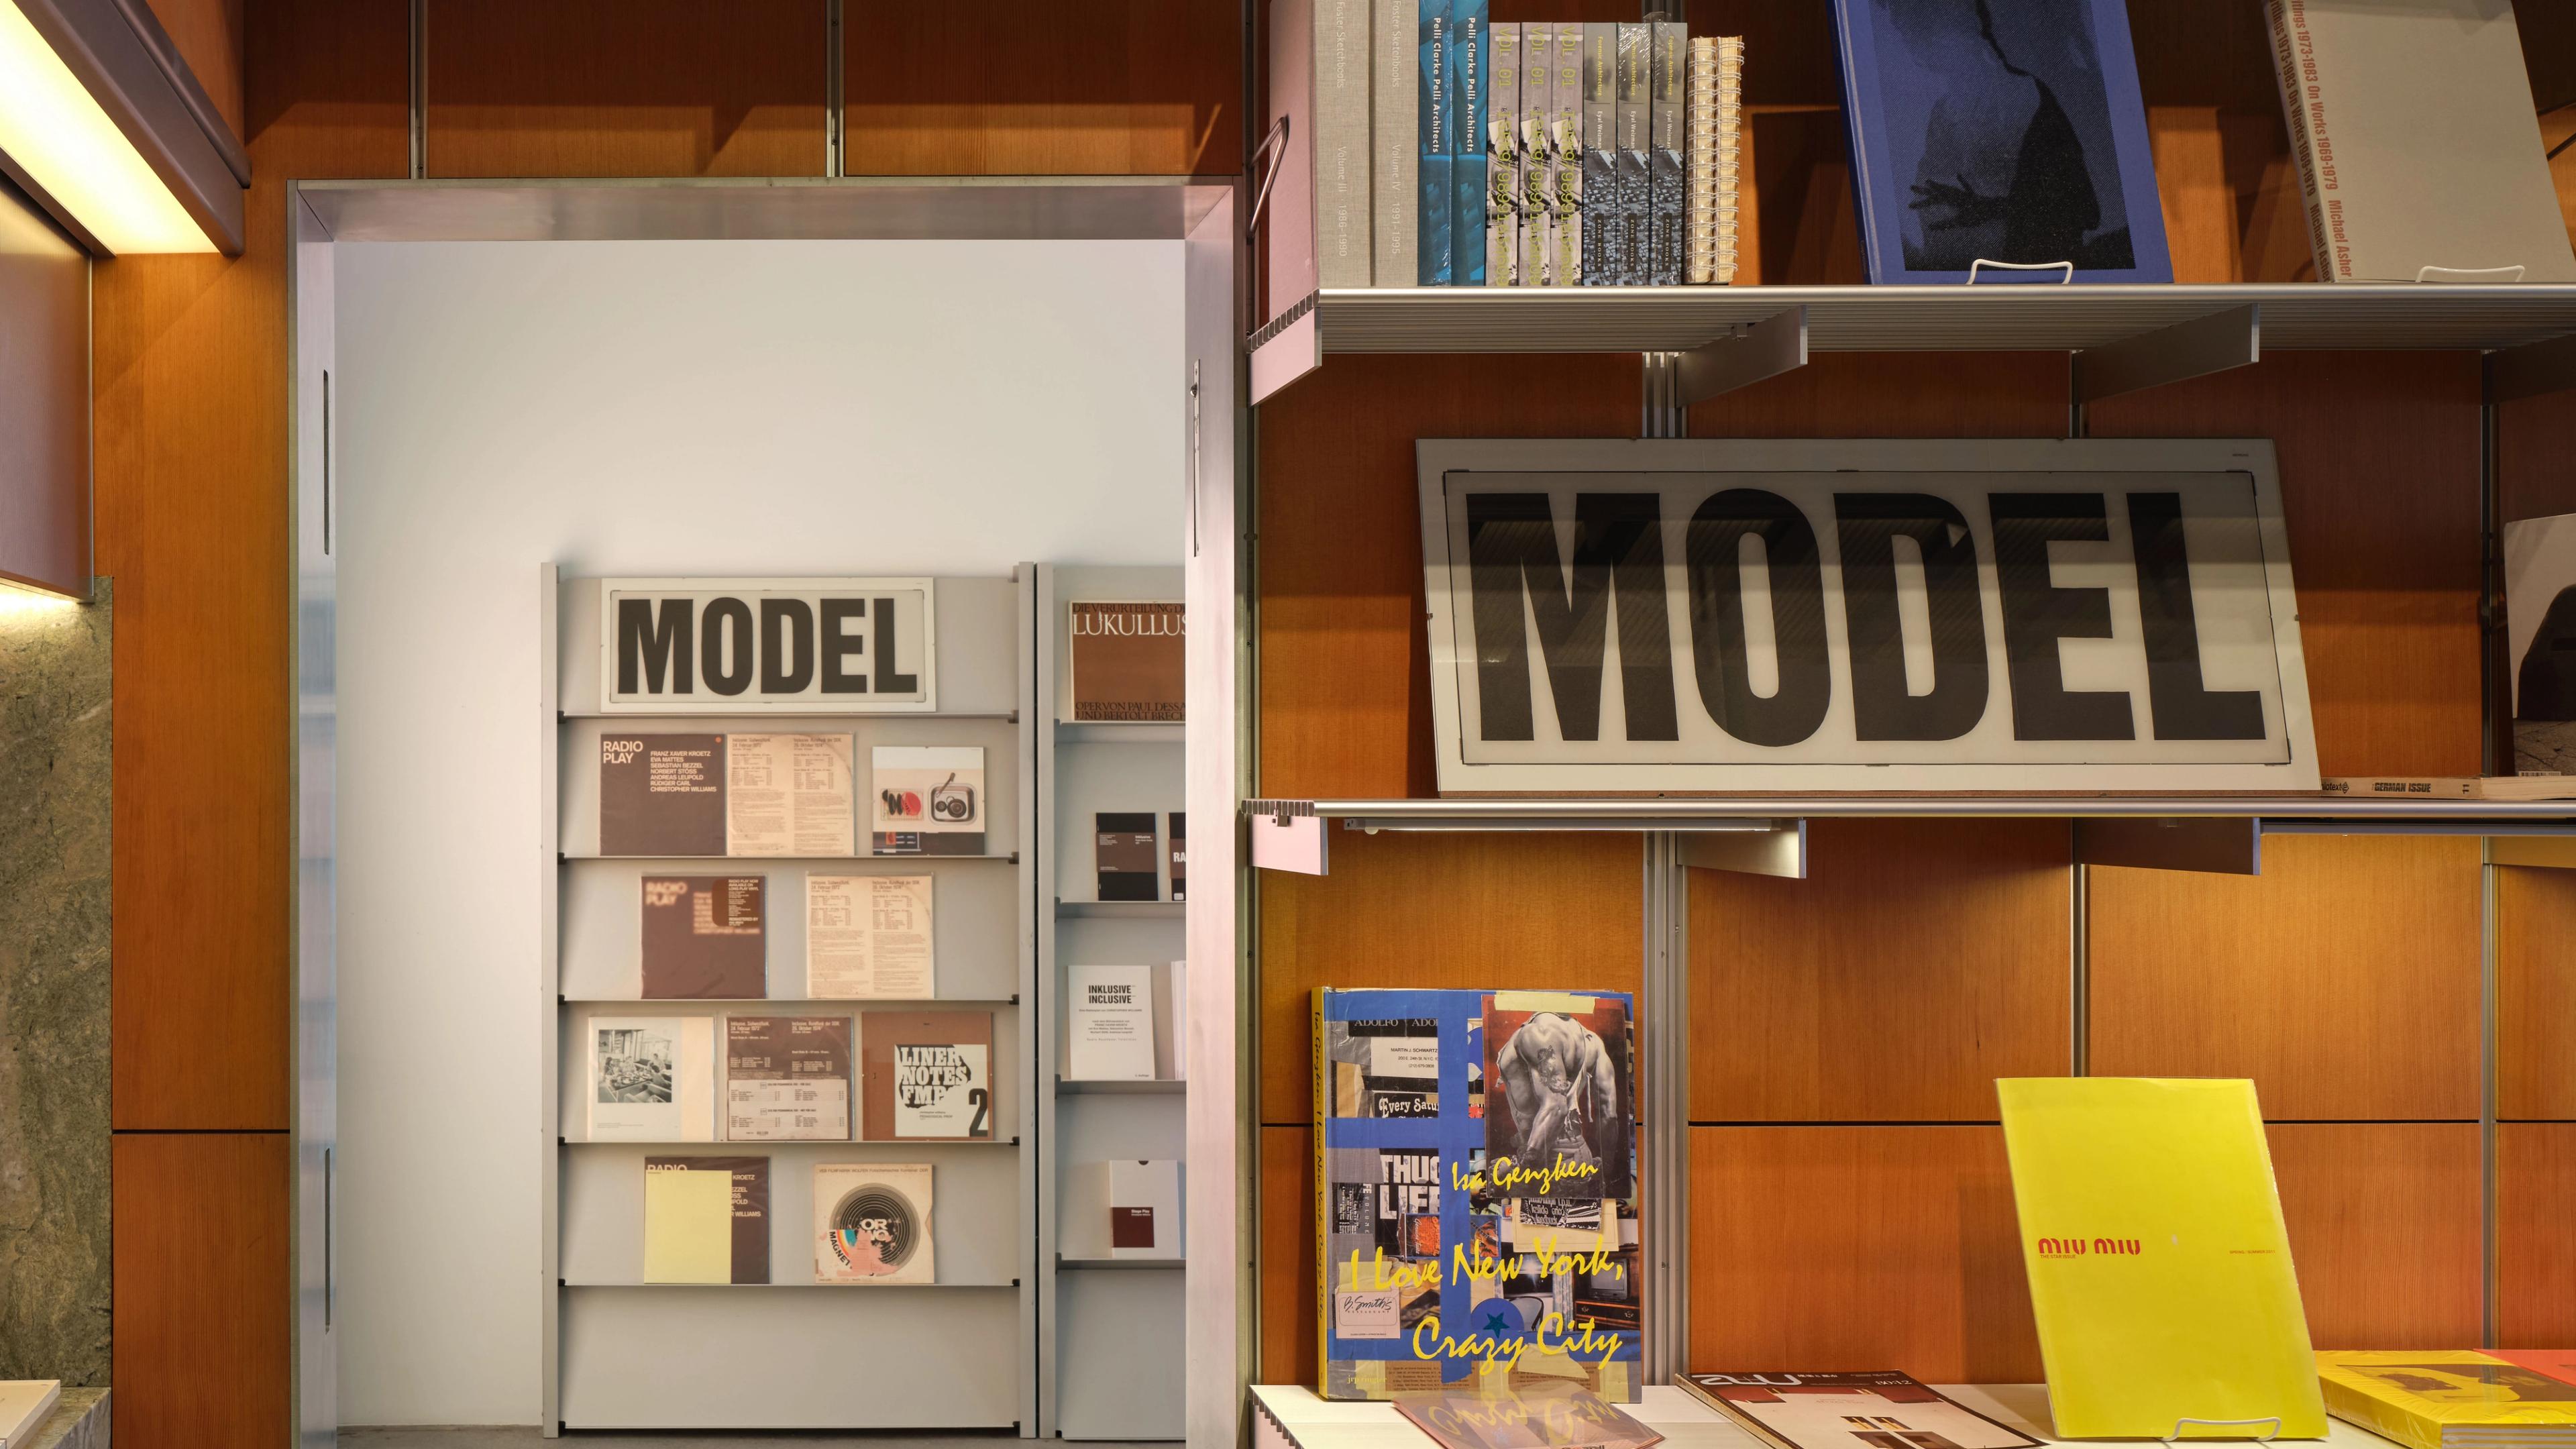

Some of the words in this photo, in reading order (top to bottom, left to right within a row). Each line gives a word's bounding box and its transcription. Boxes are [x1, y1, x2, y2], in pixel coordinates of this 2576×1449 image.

[1468, 17, 1476, 39] Pelli
[1336, 32, 1346, 89] Sketchbooks
[1391, 31, 1401, 87] Sketchbooks
[1468, 42, 1476, 74] Clarke
[2277, 34, 2300, 89] 1973-1983
[2297, 30, 2318, 82] 1973-1983
[1467, 78, 1475, 100] Pelli
[2288, 90, 2301, 105] On
[2307, 85, 2320, 99] On
[1432, 103, 1440, 153] Architects
[1467, 103, 1475, 152] Architects
[2291, 107, 2306, 142] Works
[2311, 102, 2327, 135] Works
[1338, 146, 1346, 180] Volume
[1391, 144, 1401, 178] Volume
[2298, 140, 2316, 197] 1969-1979
[2317, 137, 2338, 190] 1969-1979
[1391, 181, 1401, 191] IV
[2310, 203, 2325, 248] Michael
[2328, 200, 2348, 243] Michael
[2316, 250, 2331, 282] Asher
[2337, 245, 2353, 277] Asher
[1073, 604, 1090, 613] DIE
[1092, 603, 1173, 613] VERURTEILUNG
[1466, 487, 2266, 748] MODEL
[618, 597, 918, 696] MODEL
[1075, 703, 1103, 711] OPER
[1103, 703, 1125, 711] VON
[1128, 703, 1154, 711] PAUL
[1075, 712, 1102, 720] UND
[1104, 712, 1150, 720] BERTOLT
[604, 741, 644, 752] RADIO
[604, 753, 635, 764] PLAY
[2375, 782, 2406, 792] GERMAN
[2408, 783, 2431, 793] ISSUE
[645, 881, 688, 894] RADIO
[645, 894, 678, 906] PLAY
[1088, 985, 1132, 994] INKLUSIVE
[1089, 995, 1132, 1004] INCLUSIVE
[900, 1046, 962, 1066] LINER
[902, 1066, 968, 1085] NOTES
[902, 1085, 947, 1104] FMP
[1379, 1097, 1411, 1118] Every
[969, 1088, 988, 1137] 2
[1315, 1155, 1323, 1185] New
[1451, 1161, 1487, 1192] Isa
[1491, 1153, 1600, 1195] Genzken
[1314, 1233, 1324, 1281] Crazy
[1375, 1246, 1444, 1290] Love
[1452, 1238, 1524, 1285] New
[1533, 1234, 1623, 1281] York,
[1315, 1285, 1324, 1320] City
[1412, 1315, 1528, 1376] Crazy
[1537, 1311, 1623, 1371] City
